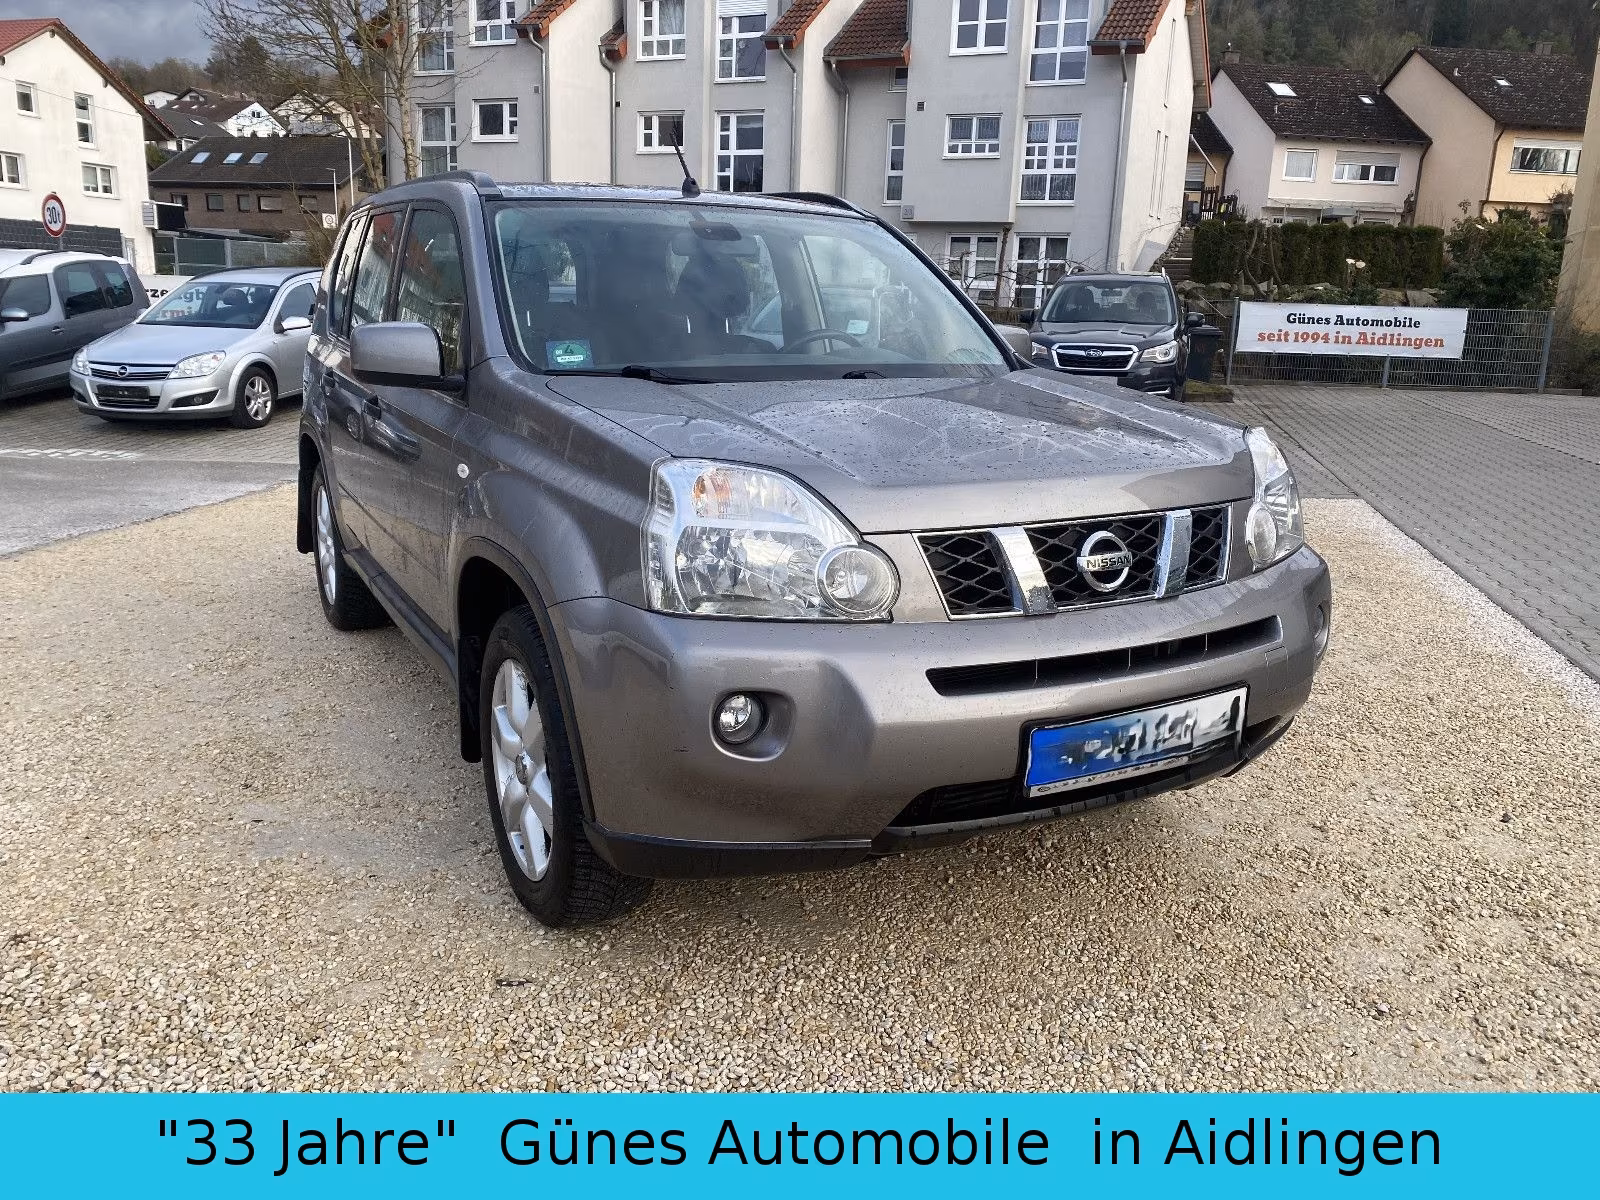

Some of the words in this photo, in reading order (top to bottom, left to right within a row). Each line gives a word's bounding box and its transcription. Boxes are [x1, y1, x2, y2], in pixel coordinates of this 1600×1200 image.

[1286, 312, 1331, 326] Günes
[1333, 314, 1421, 329] Automobile
[1257, 329, 1290, 343] seit
[1293, 330, 1331, 344] 1994
[1333, 331, 1353, 345] in
[1355, 331, 1445, 350] Aidlingen
[1086, 554, 1130, 569] NISSAN
